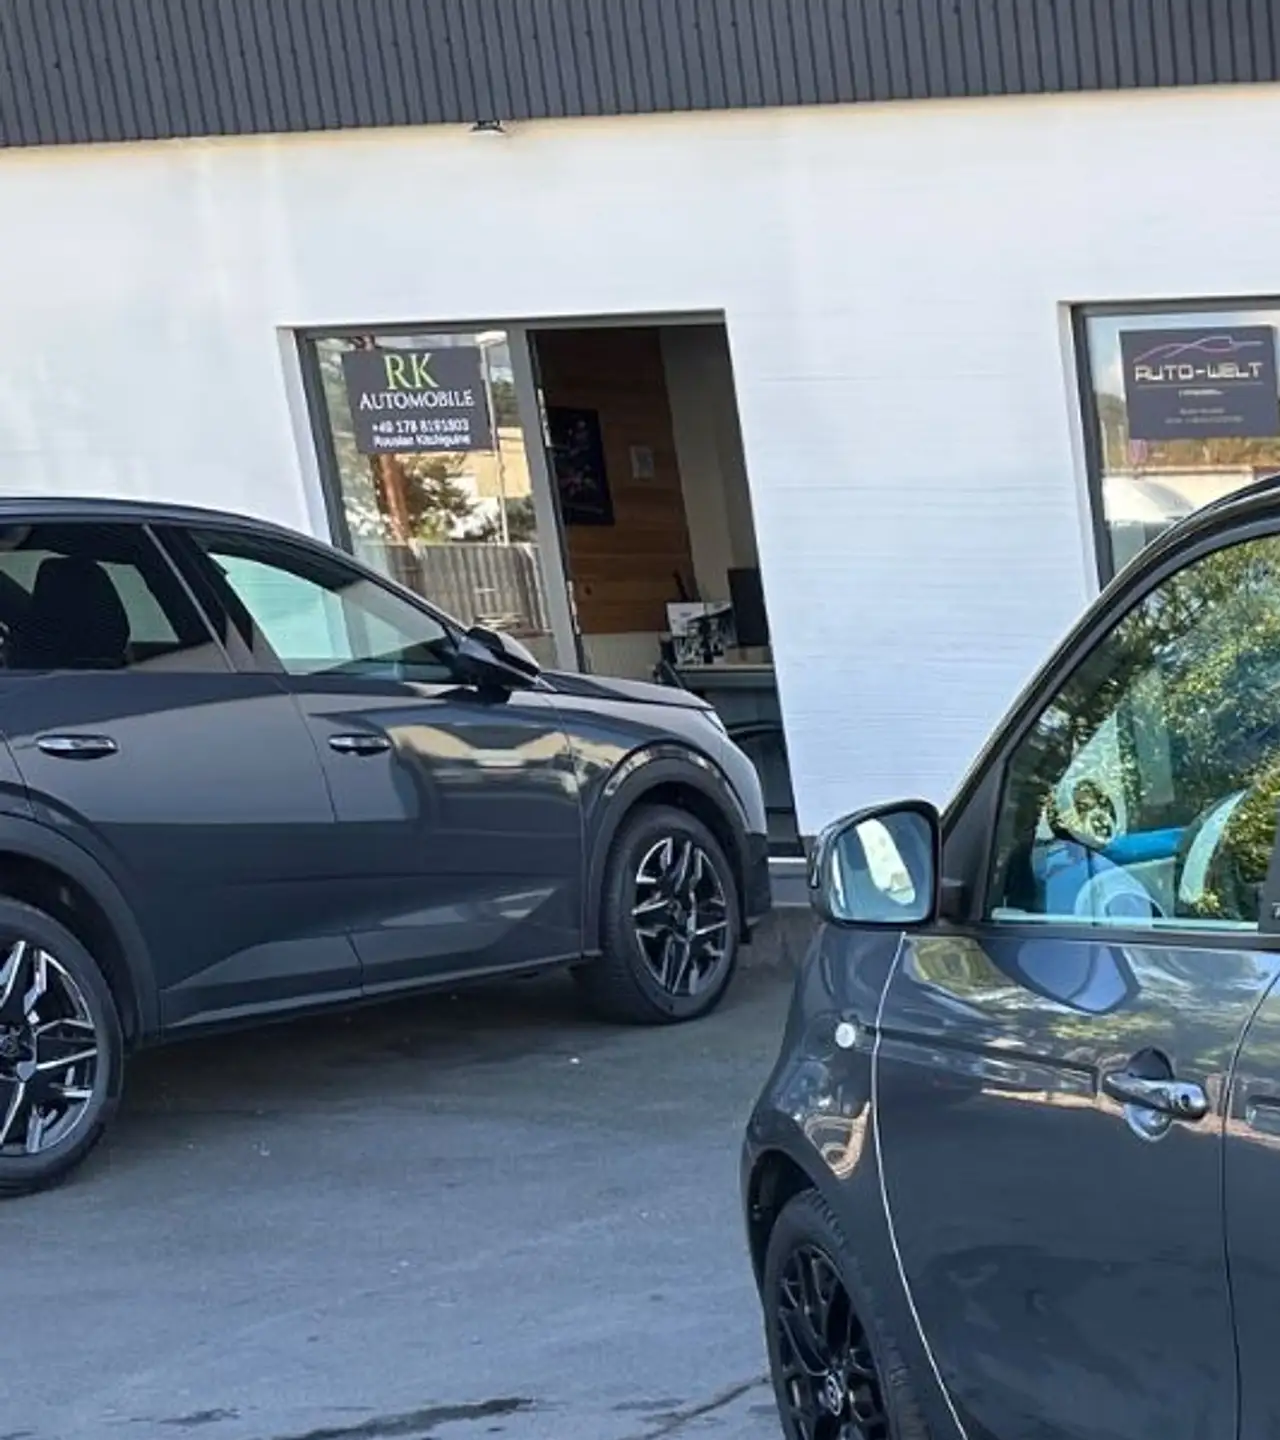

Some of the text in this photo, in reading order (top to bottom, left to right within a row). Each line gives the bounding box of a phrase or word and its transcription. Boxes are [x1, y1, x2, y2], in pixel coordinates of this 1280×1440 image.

[384, 352, 439, 390] RK
[1135, 362, 1263, 382] AUTO-WELT
[360, 389, 475, 410] AUTOMOBILE
